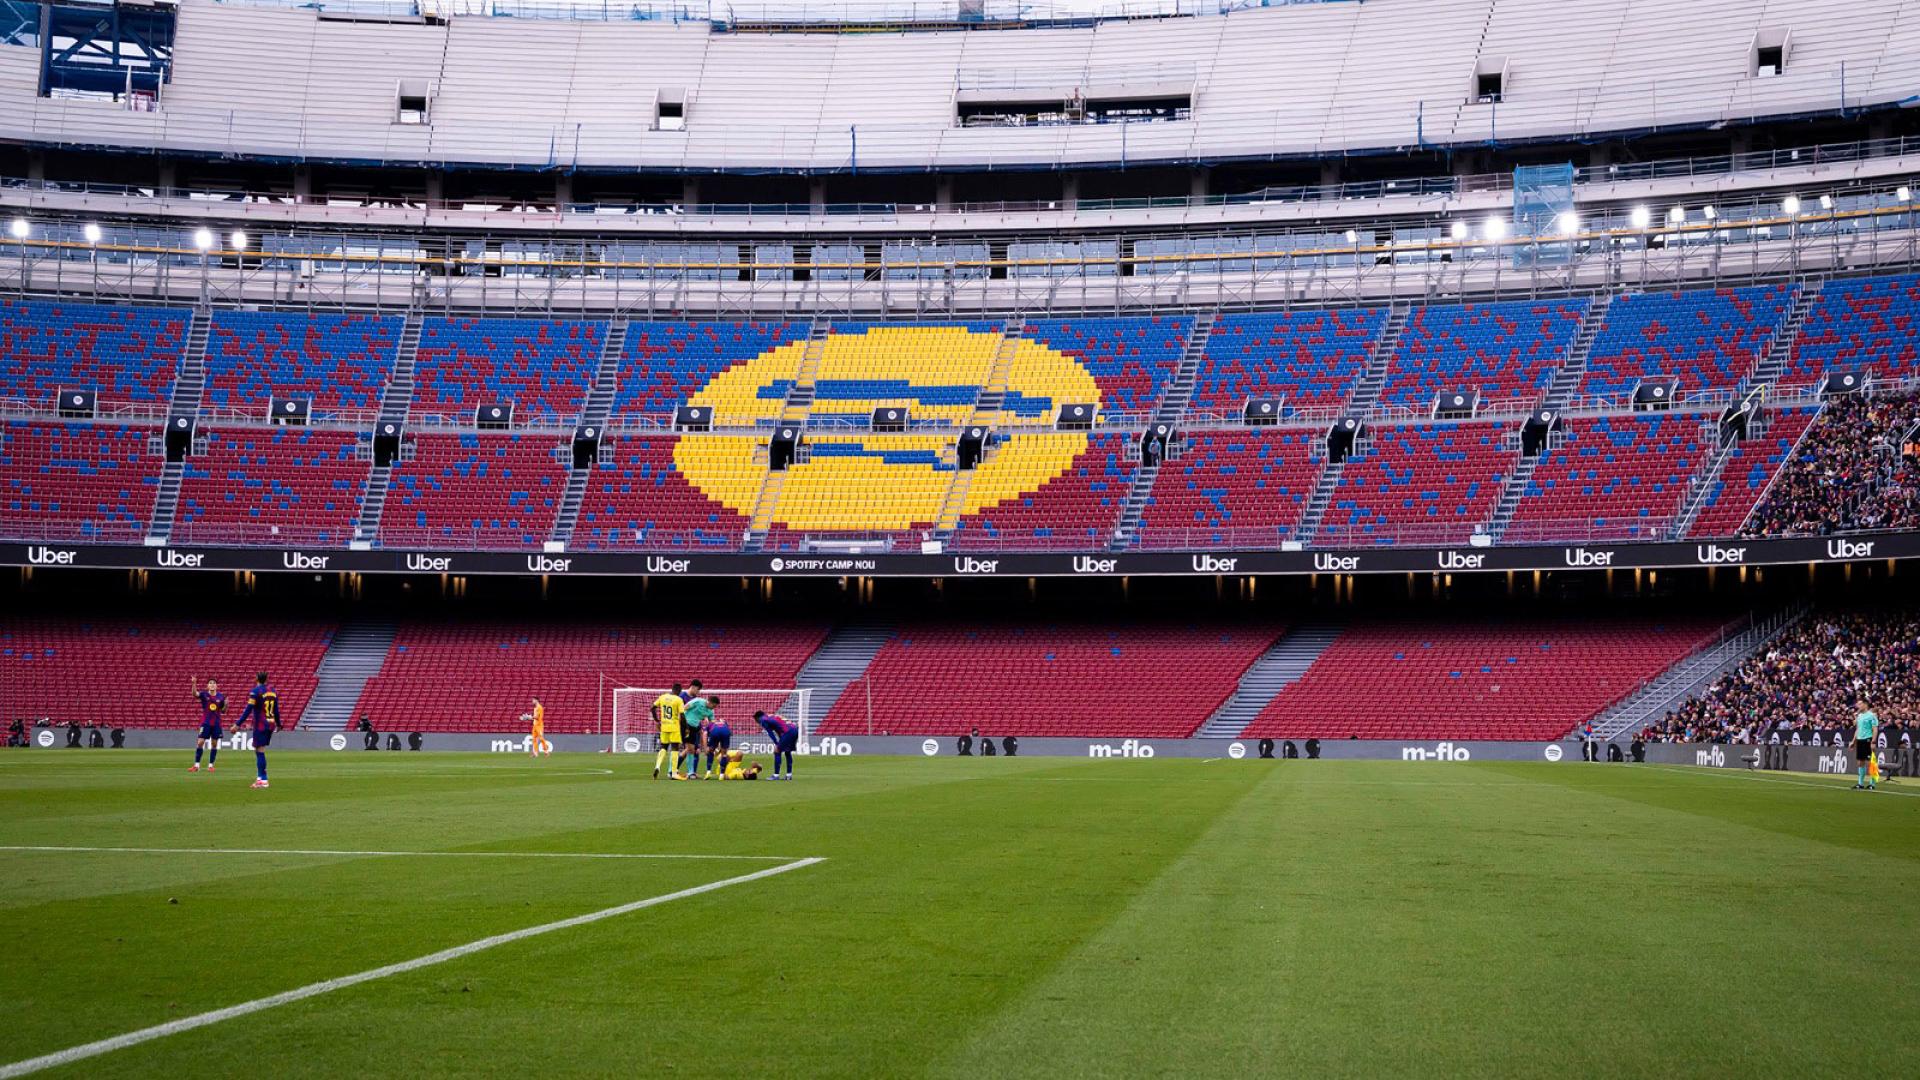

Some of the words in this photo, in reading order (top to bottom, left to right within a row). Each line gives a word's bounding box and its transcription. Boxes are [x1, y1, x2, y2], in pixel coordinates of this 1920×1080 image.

[28, 547, 75, 564] Uber
[1565, 549, 1615, 566] Uber
[1697, 545, 1747, 563] Uber
[1827, 540, 1875, 558] Uber
[157, 550, 205, 567] Uber
[283, 552, 330, 569] Uber
[406, 554, 452, 570] Uber
[527, 555, 572, 572] Uber
[646, 556, 691, 573] Uber
[785, 560, 824, 569] SPOTIFY
[826, 560, 853, 569] CAMP
[855, 560, 875, 569] NOU
[955, 556, 999, 573] Uber
[1073, 556, 1118, 572] Uber
[1192, 555, 1238, 572] Uber
[1314, 553, 1361, 570] Uber
[1438, 551, 1486, 568] Uber
[663, 705, 673, 719] 19
[1089, 739, 1154, 757] m-flo
[1402, 743, 1470, 761] m-flo
[1696, 745, 1725, 767] m-flo
[1819, 749, 1847, 773] m-flo
